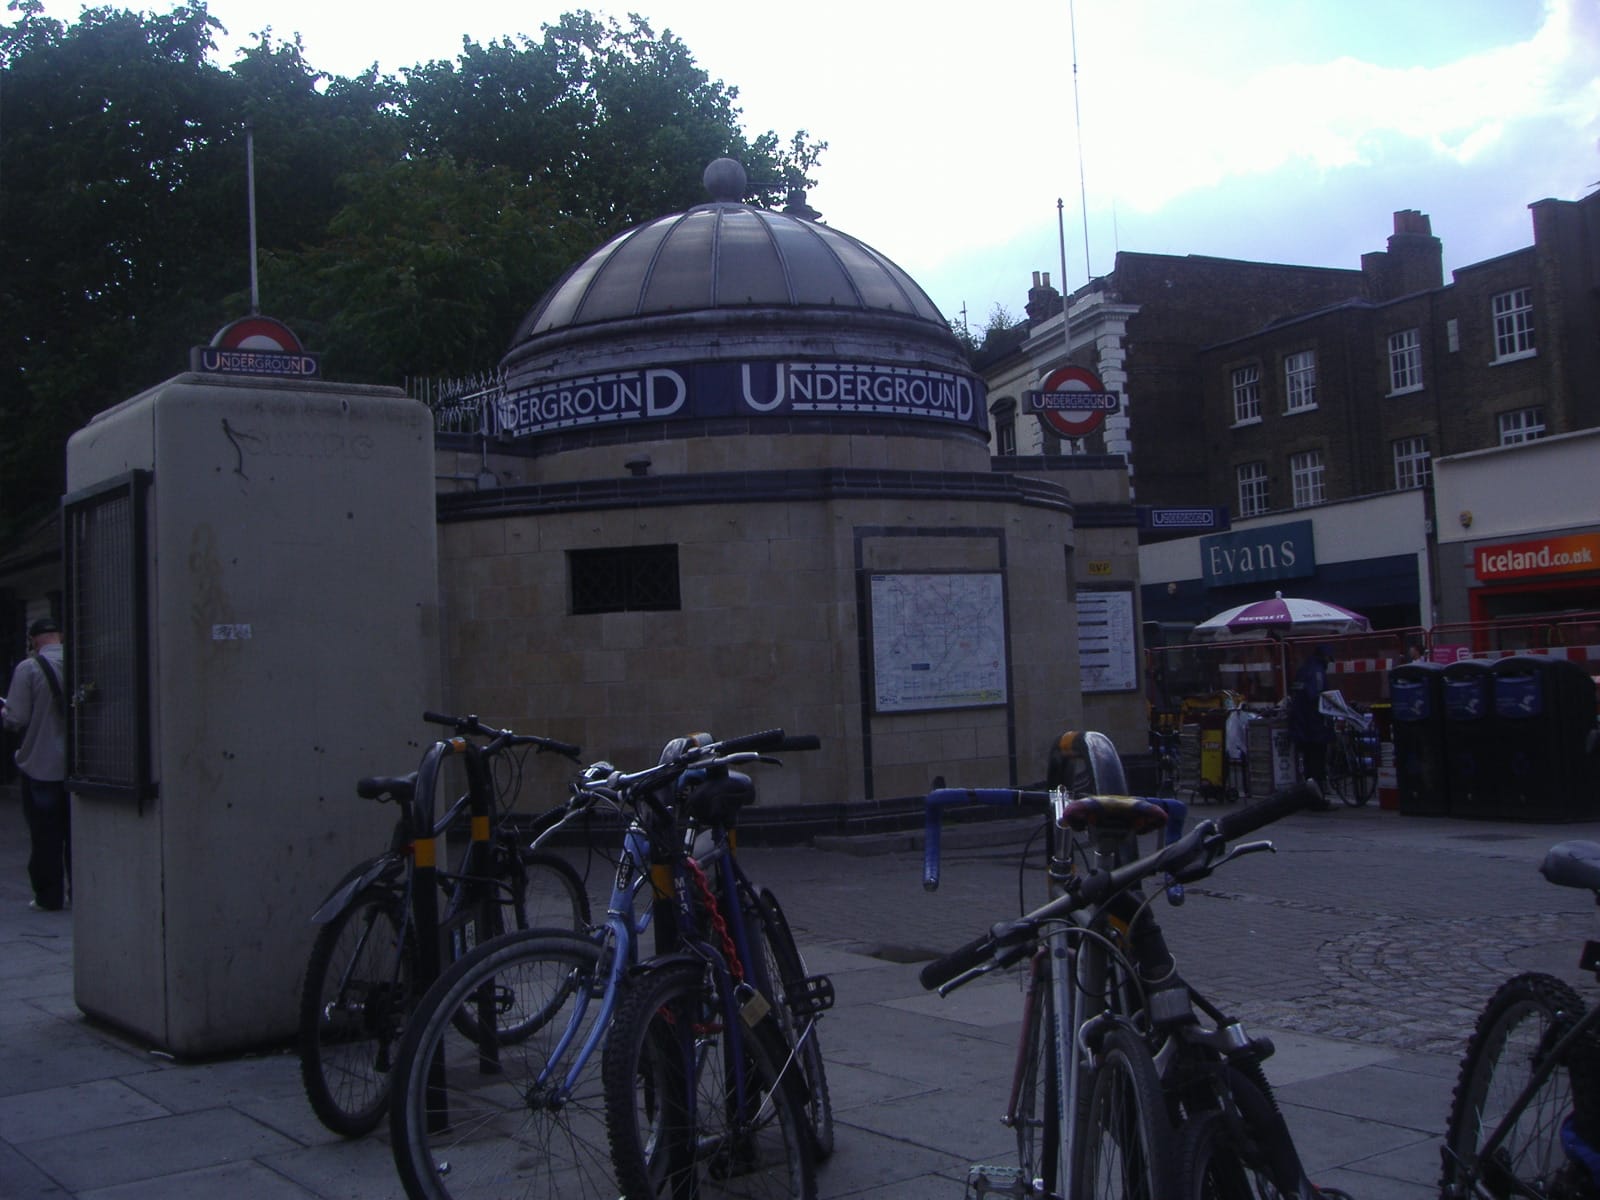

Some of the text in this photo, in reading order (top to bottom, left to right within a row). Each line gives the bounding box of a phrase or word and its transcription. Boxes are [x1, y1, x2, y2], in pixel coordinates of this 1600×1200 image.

[203, 351, 317, 375] UNDERGROUND
[740, 362, 974, 421] UNDERGROUND
[1031, 393, 1118, 409] UNDERGROUND
[1208, 540, 1297, 576] Evans
[1480, 546, 1593, 573] Iceland.co.uk
